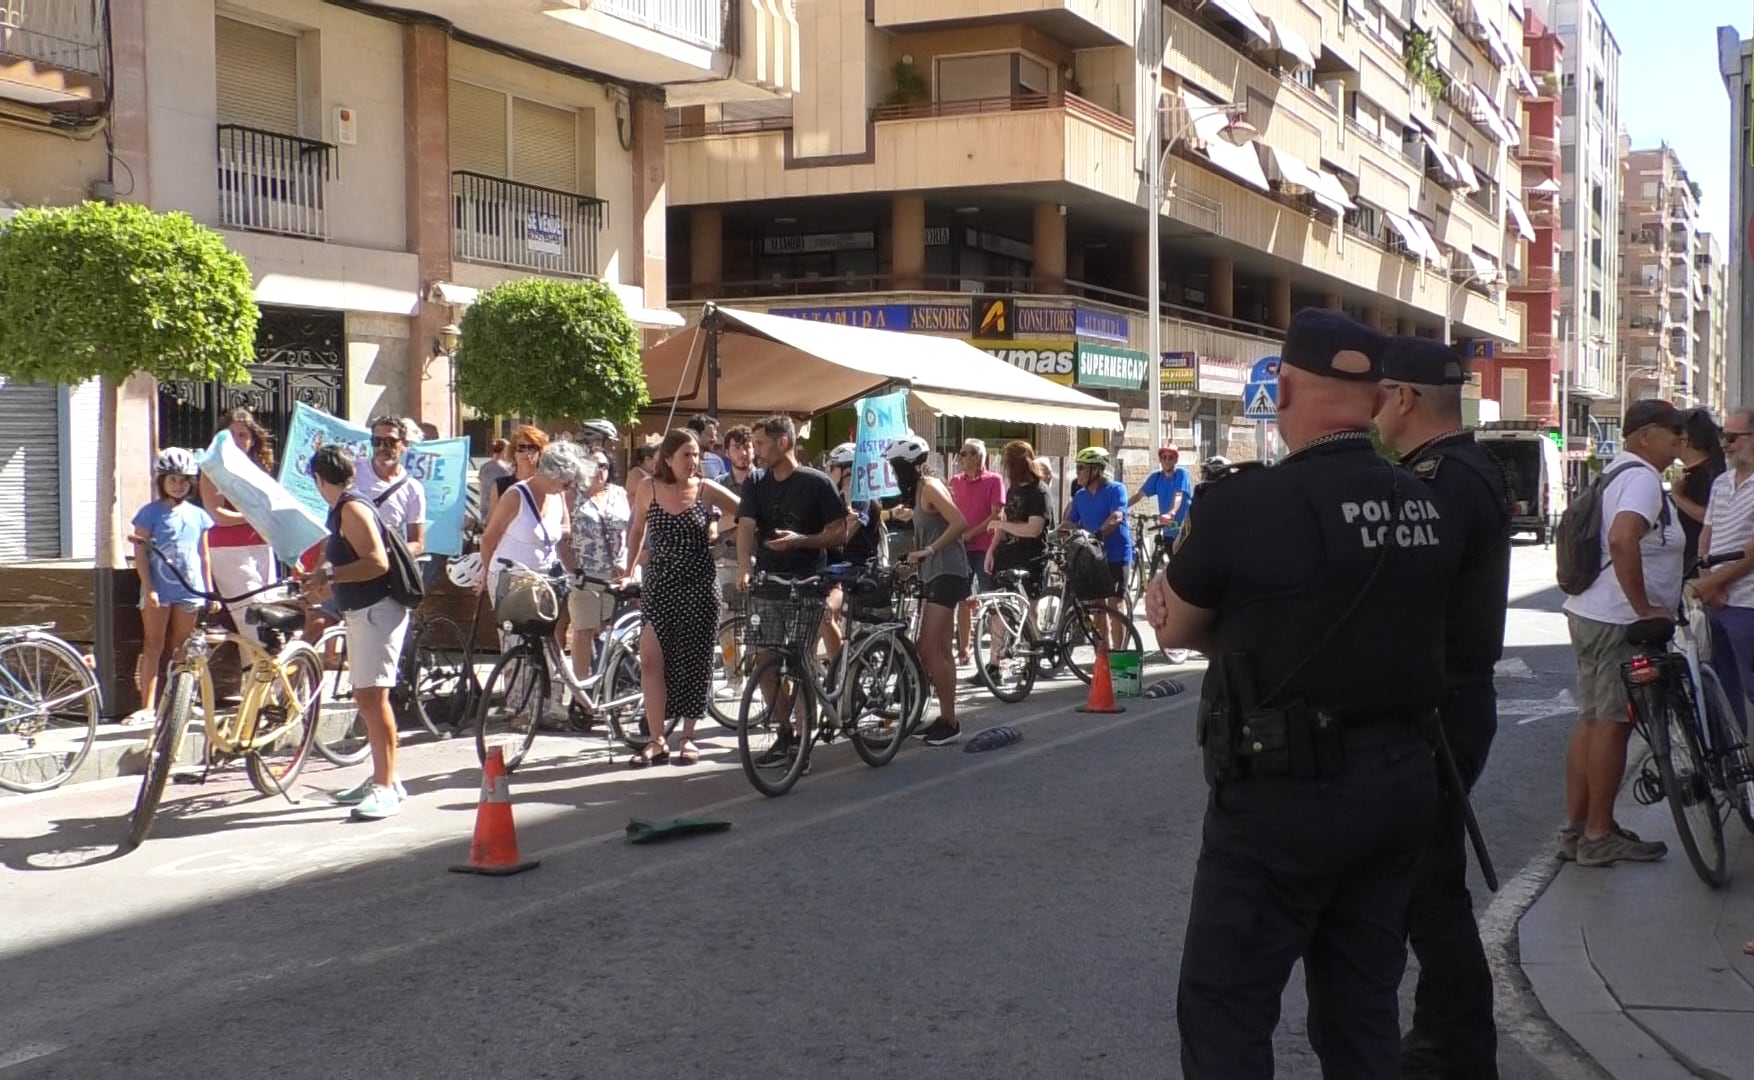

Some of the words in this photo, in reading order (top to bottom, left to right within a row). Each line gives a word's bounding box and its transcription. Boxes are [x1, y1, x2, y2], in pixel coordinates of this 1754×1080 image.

[793, 310, 886, 327] TAMIRA
[911, 307, 969, 329] ASESORES
[1018, 308, 1074, 331] CONSULTORES
